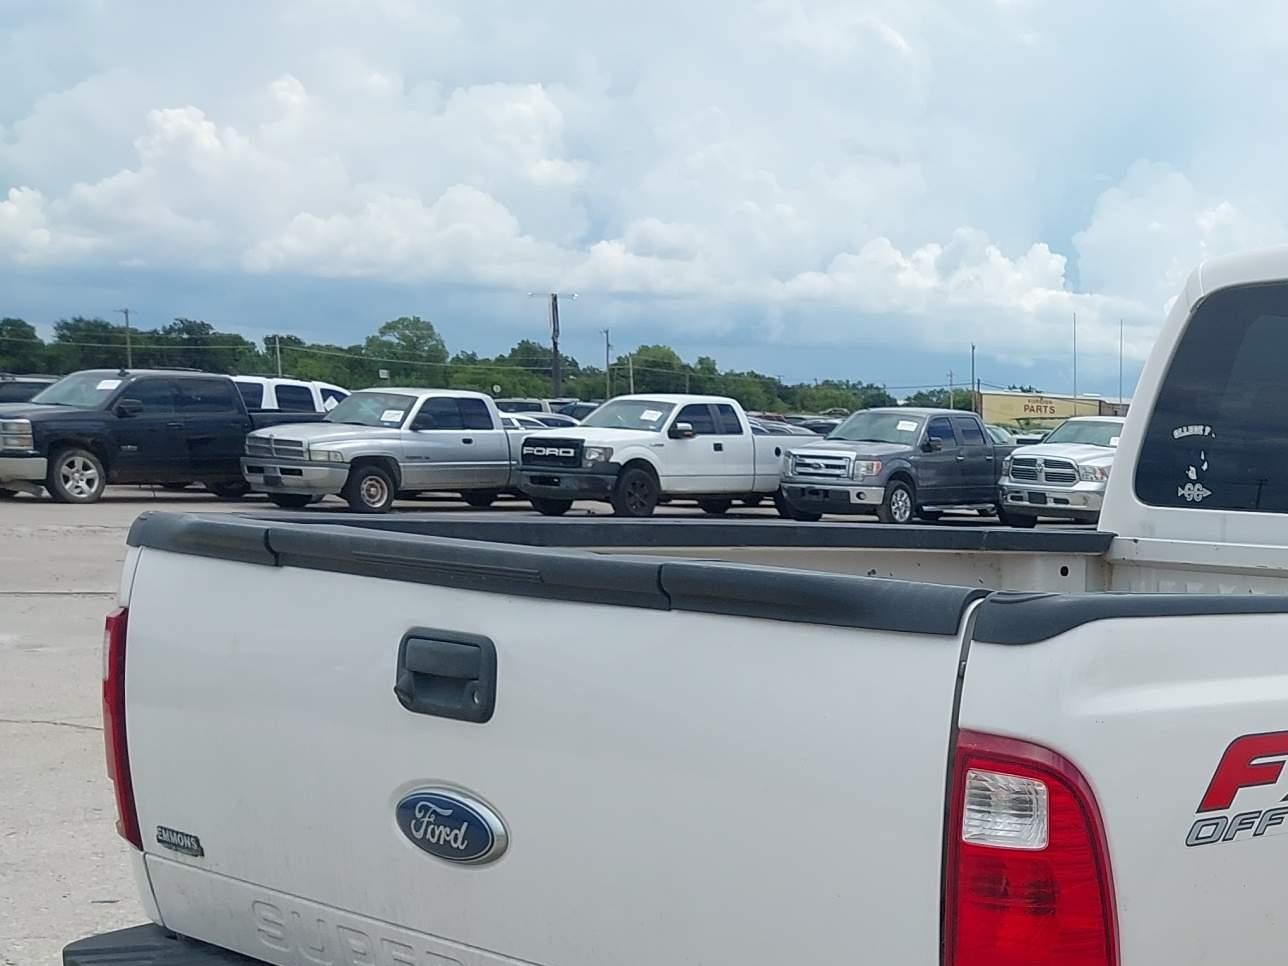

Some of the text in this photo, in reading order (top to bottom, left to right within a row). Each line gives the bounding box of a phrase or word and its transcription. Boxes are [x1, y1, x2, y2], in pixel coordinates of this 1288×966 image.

[1023, 404, 1056, 415] PARTS
[523, 446, 575, 457] FORD
[410, 800, 469, 850] Ford
[157, 827, 198, 850] EMMONS
